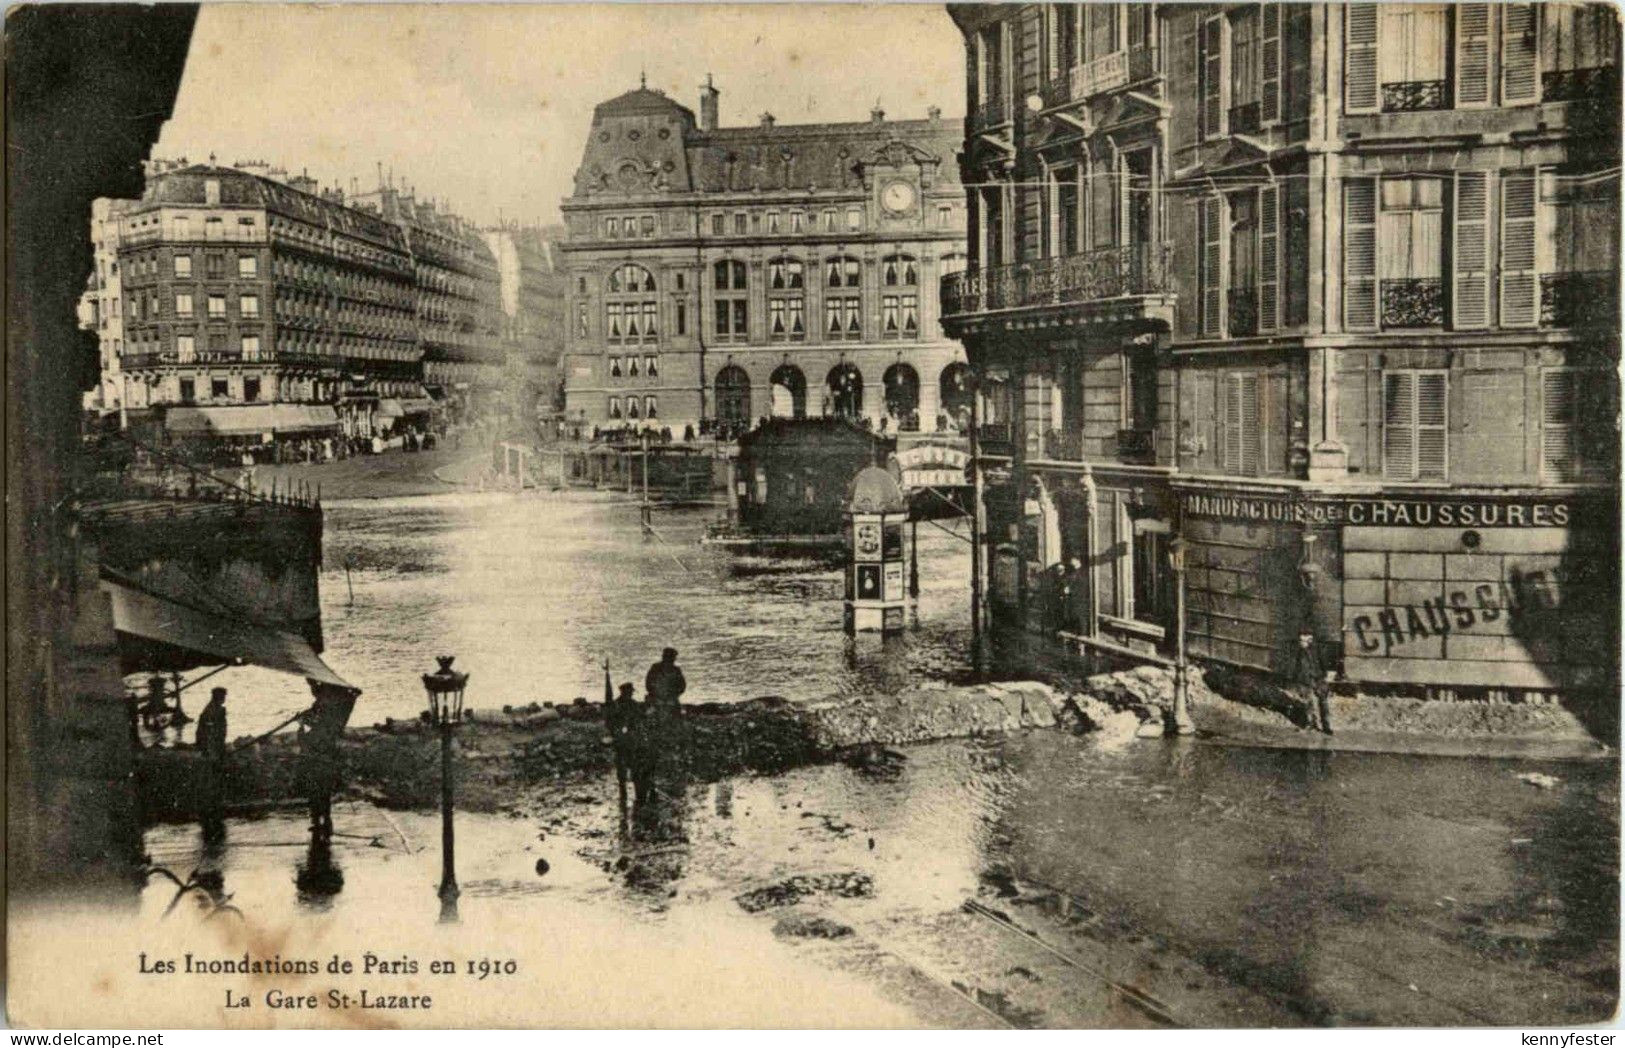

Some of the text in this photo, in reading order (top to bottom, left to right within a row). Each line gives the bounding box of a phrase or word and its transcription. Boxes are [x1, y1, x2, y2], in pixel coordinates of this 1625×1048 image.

[1188, 495, 1569, 526] MANUFACTURE DE CHAUSSURES
